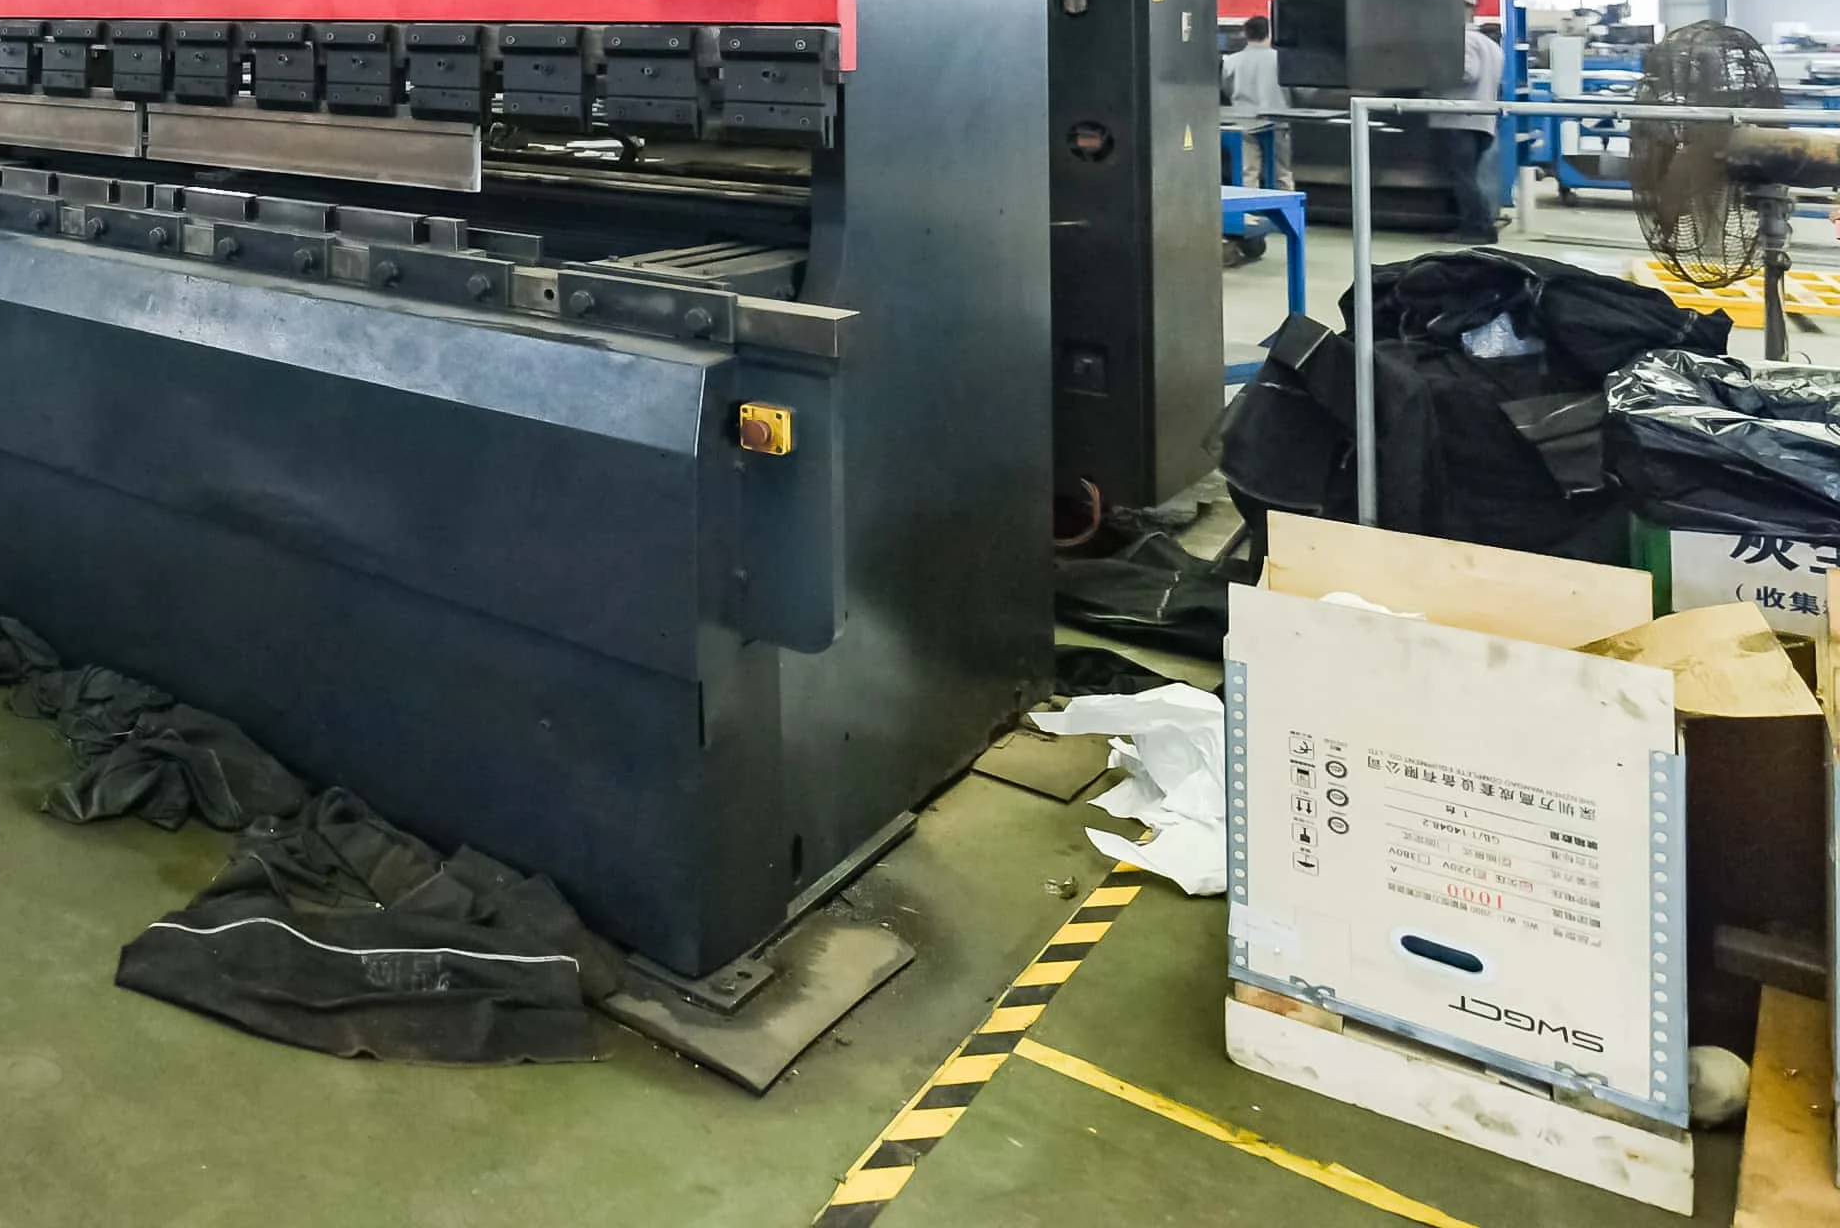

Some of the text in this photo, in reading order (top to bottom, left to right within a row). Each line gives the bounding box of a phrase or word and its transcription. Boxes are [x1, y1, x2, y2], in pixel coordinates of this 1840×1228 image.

[1735, 583, 1828, 617] (收集
[1366, 755, 1595, 821] 深圳万高成套设备有限公司
[1446, 881, 1502, 910] 1000
[1448, 995, 1605, 1054] SWGCT
